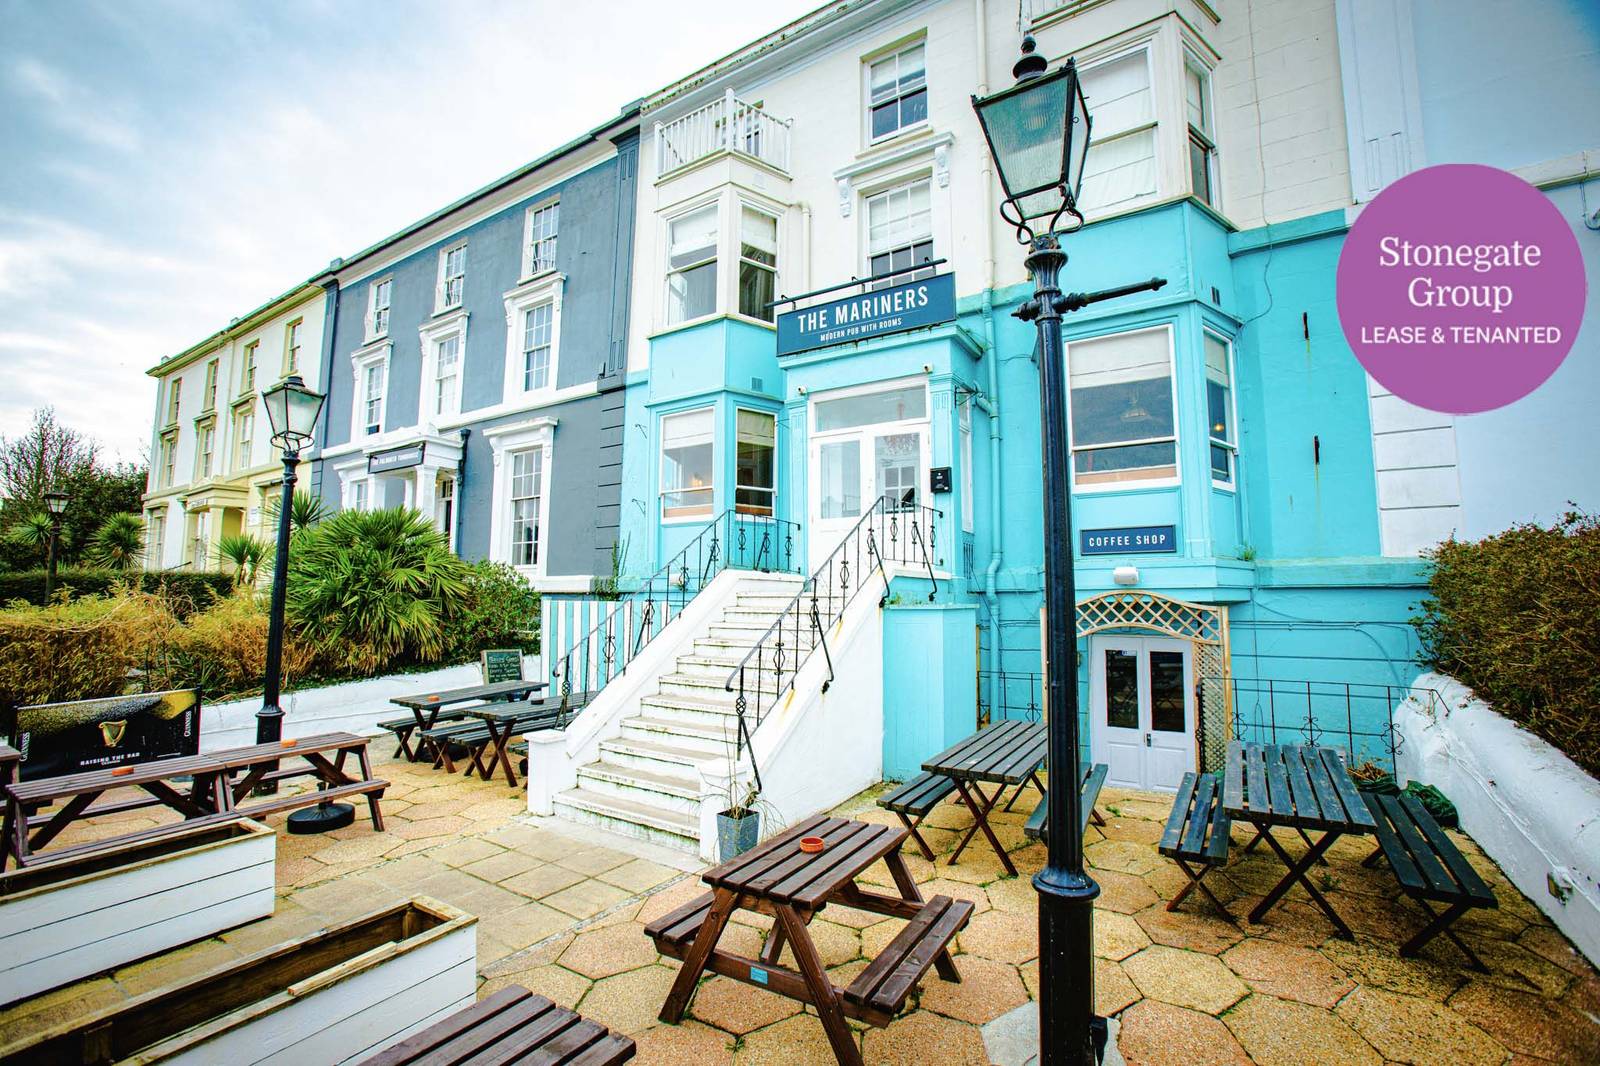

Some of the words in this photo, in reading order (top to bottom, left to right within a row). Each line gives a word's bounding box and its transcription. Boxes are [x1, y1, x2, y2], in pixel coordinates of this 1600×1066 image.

[798, 310, 828, 333] THE
[835, 286, 929, 325] MARINERS
[820, 330, 845, 342] MODERN
[847, 326, 859, 336] PUB
[861, 323, 877, 333] WITH
[879, 318, 902, 329] ROOMS
[1089, 536, 1130, 547] COFFEE
[1136, 534, 1166, 545] SHOP
[80, 756, 109, 766] RAISING
